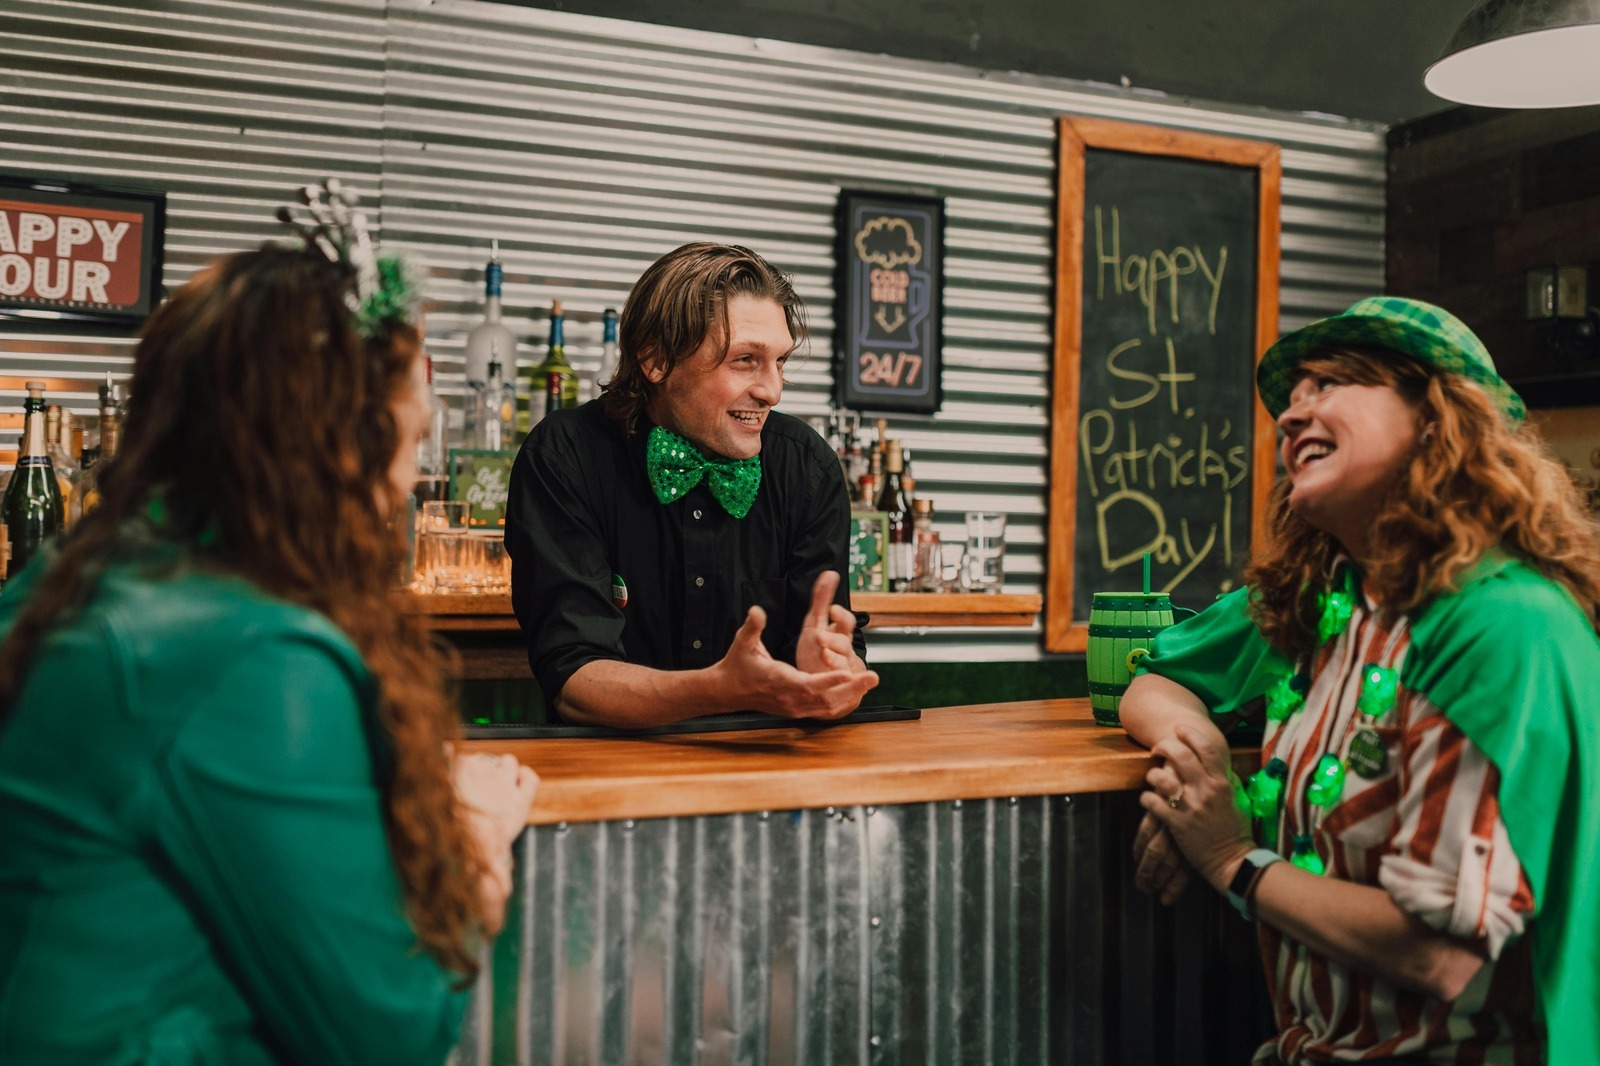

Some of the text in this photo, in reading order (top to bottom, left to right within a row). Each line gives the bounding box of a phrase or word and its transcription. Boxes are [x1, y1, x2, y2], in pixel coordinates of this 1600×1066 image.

[0, 253, 111, 303] OUR
[1094, 205, 1228, 335] Happy
[860, 351, 922, 388] 24/7
[1106, 337, 1196, 417] St.
[1080, 408, 1249, 498] Patrick's
[1097, 489, 1234, 594] Day!
